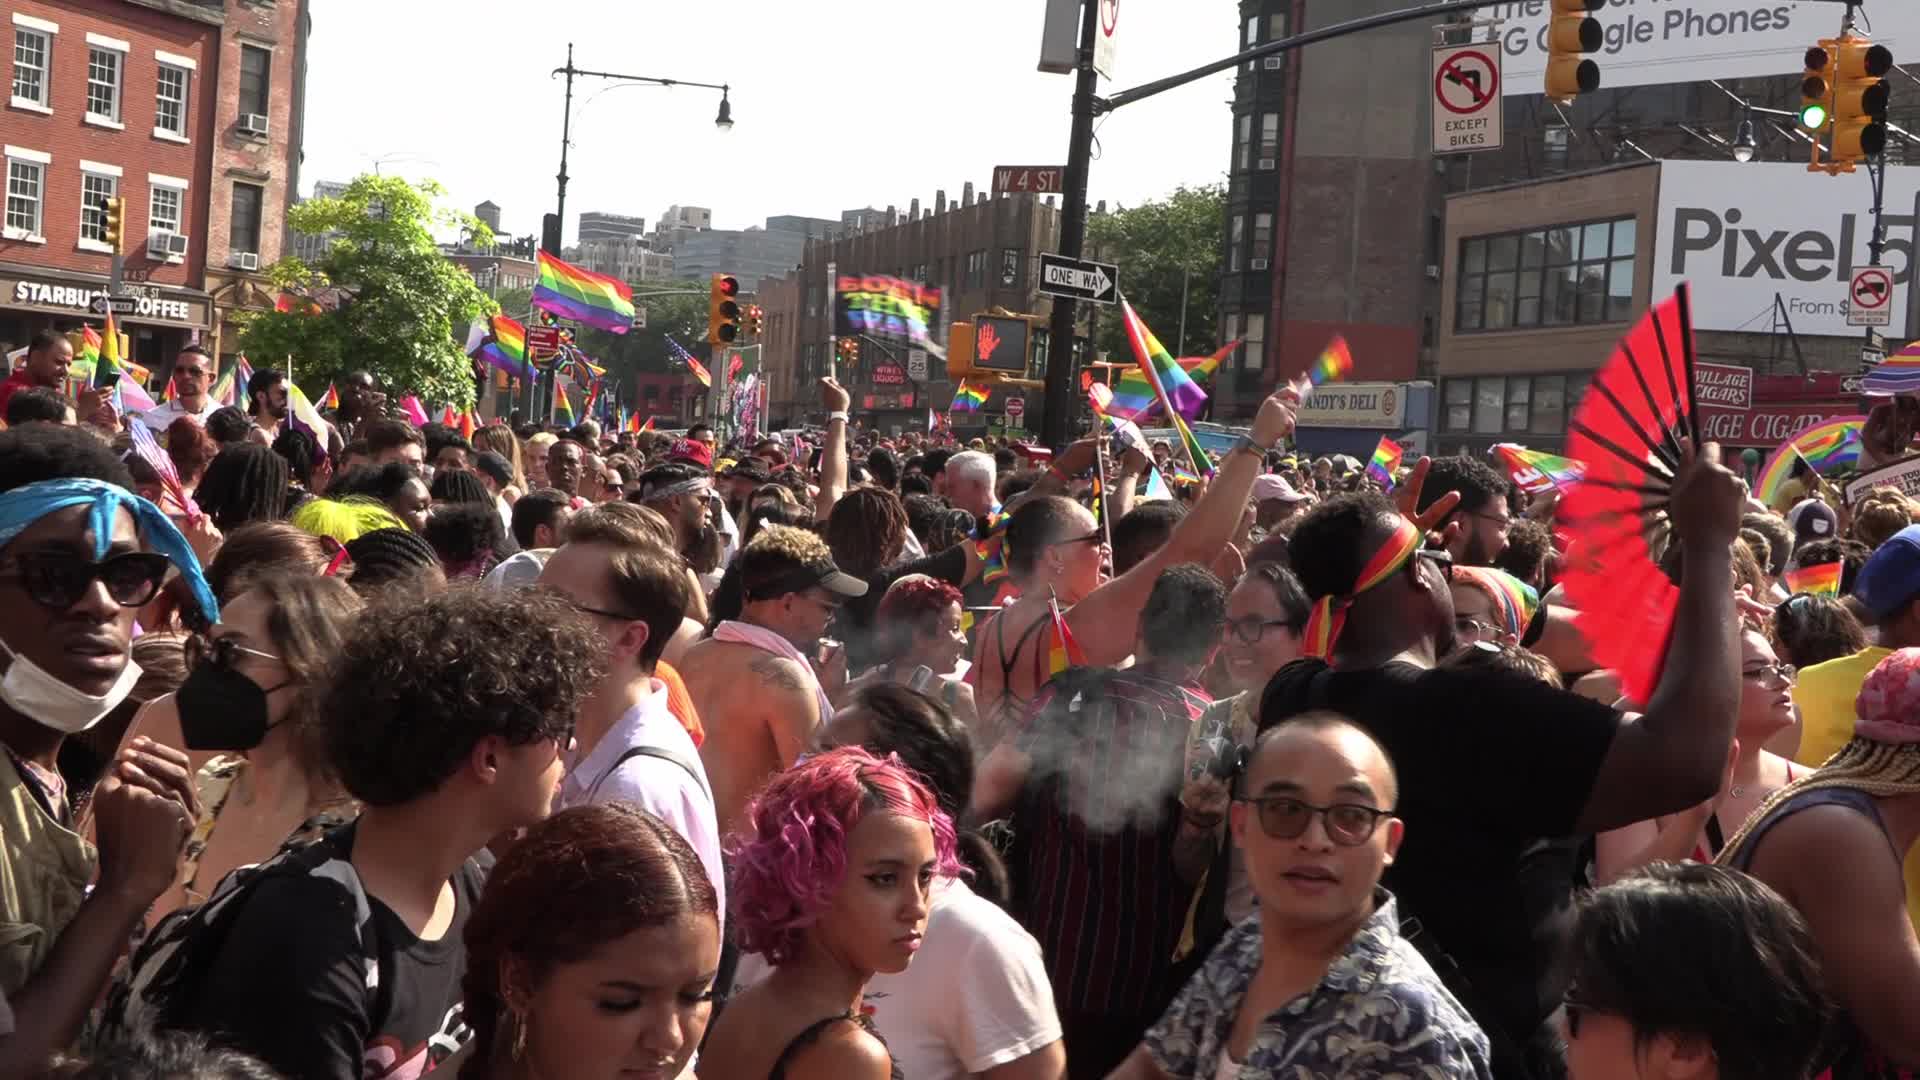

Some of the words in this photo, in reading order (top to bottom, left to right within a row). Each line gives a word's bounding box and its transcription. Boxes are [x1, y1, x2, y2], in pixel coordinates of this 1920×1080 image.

[1445, 118, 1488, 132] EXCEPT
[1450, 133, 1484, 146] BIKES
[999, 170, 1012, 190] W
[1017, 171, 1028, 190] 4
[1037, 171, 1056, 191] ST
[1671, 208, 1856, 282] Pixel
[1878, 214, 1915, 285] 5
[1050, 267, 1073, 285] ONE
[1083, 273, 1106, 290] WAY
[16, 281, 112, 308] STARBU
[151, 287, 160, 298] ST
[1789, 298, 1834, 315] From
[911, 361, 925, 372] 25
[1696, 370, 1749, 388] VILLAGE
[1349, 394, 1377, 410] DELI
[1696, 384, 1745, 404] CIGARS
